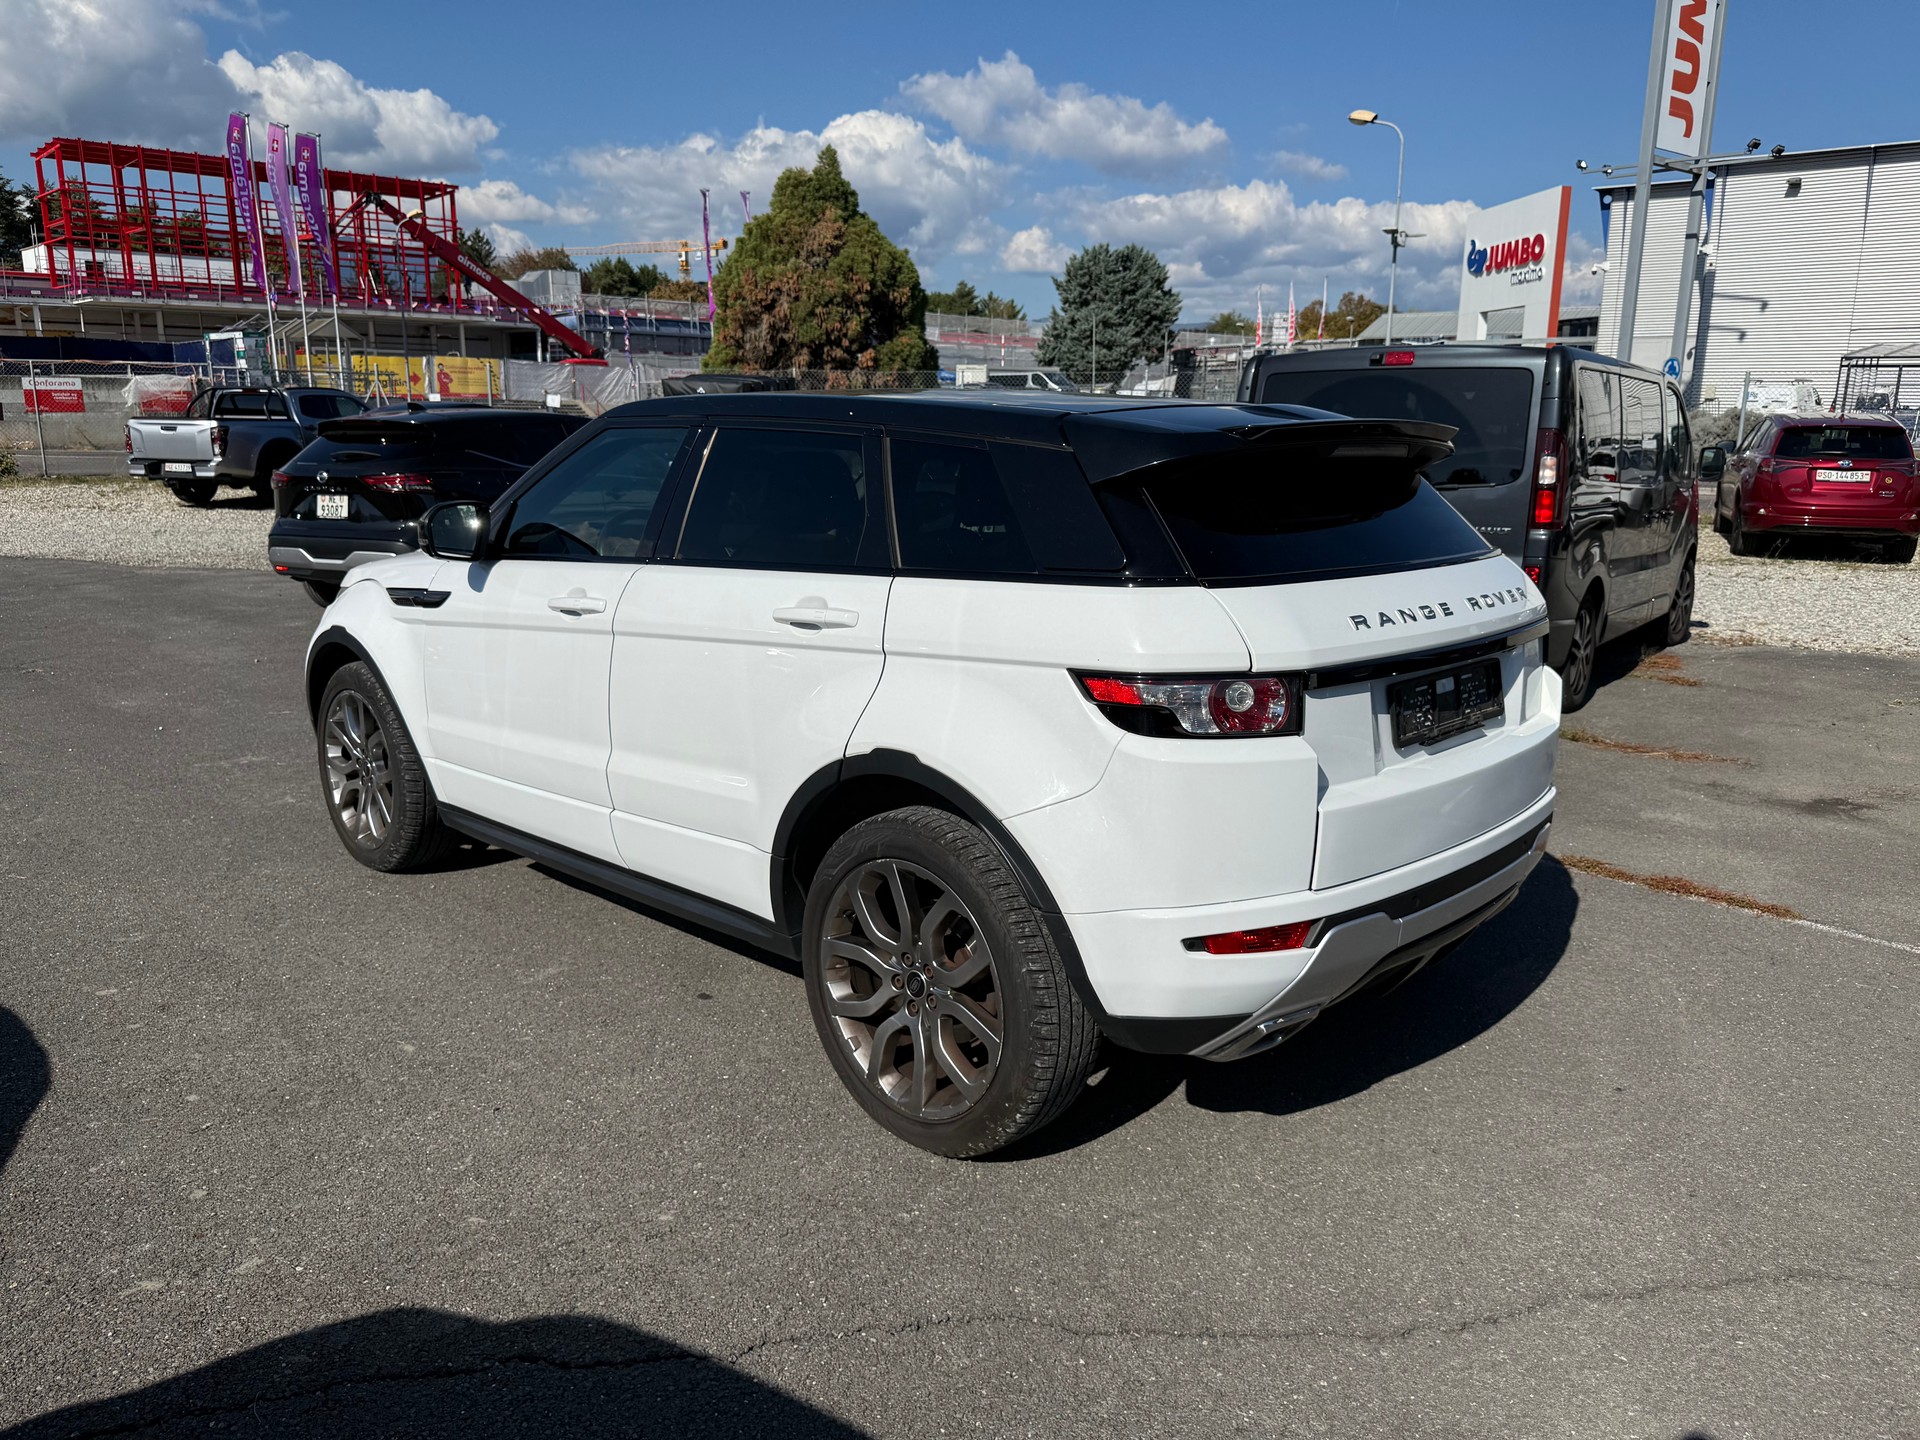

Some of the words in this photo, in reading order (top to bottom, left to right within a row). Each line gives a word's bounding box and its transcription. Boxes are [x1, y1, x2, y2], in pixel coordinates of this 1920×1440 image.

[1485, 233, 1545, 272] JUMBO
[28, 379, 76, 387] Conforama
[321, 504, 343, 517] 93087
[1348, 600, 1454, 631] RANGE
[1464, 586, 1528, 613] ROVER
